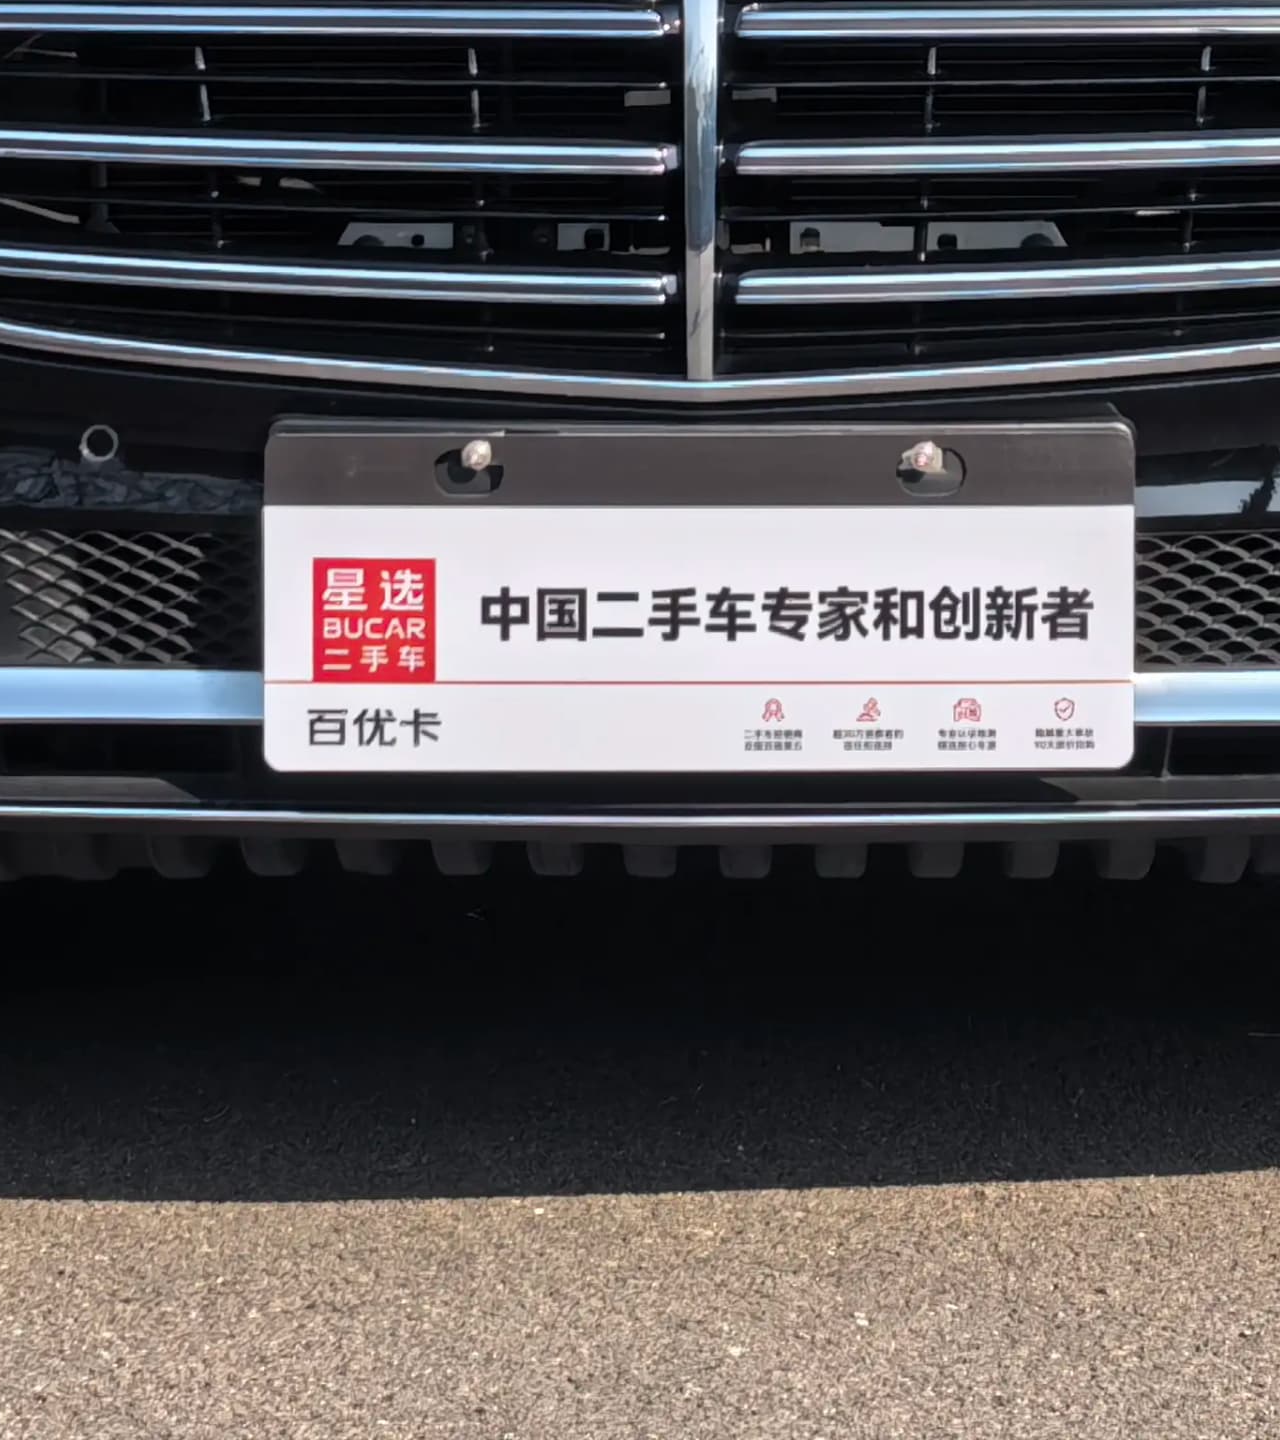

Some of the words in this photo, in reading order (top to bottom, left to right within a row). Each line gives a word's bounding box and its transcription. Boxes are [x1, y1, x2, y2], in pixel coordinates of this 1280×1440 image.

[322, 568, 424, 611] 星选
[322, 618, 426, 639] BUCAR
[481, 585, 1094, 642] 中国二手车专家和创新者
[322, 645, 425, 672] 二手车
[307, 708, 442, 746] 百优卡
